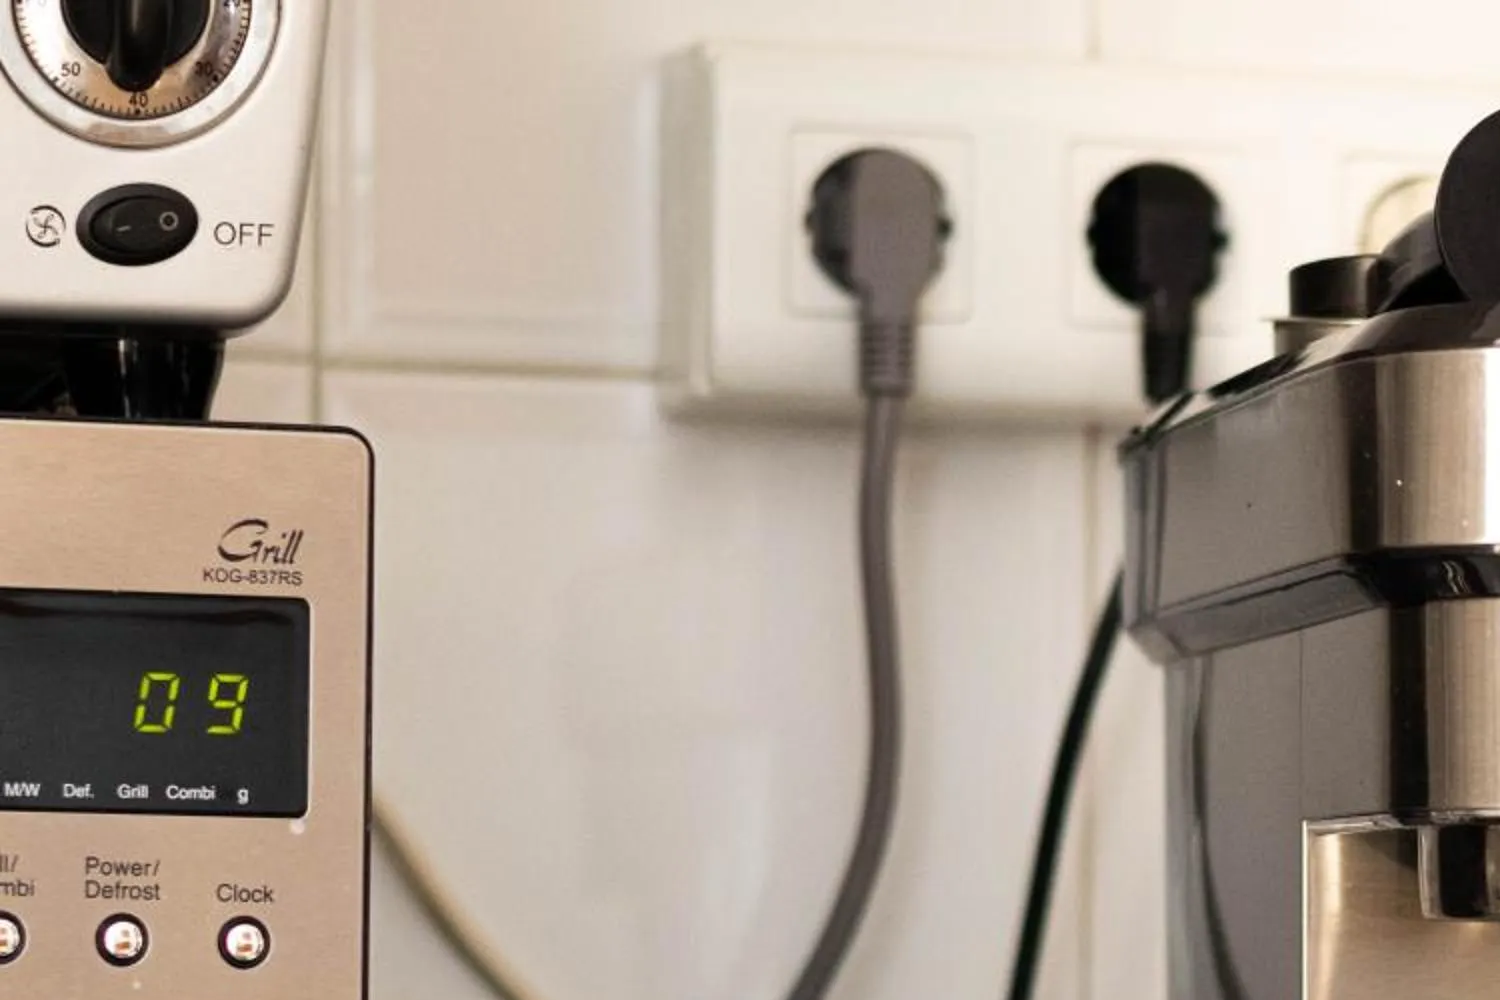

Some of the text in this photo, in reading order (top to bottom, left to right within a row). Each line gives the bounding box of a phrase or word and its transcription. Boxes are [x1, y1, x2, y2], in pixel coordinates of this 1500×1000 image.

[61, 62, 81, 77] 50
[129, 92, 148, 108] 40
[213, 222, 275, 246] OFF
[217, 518, 304, 564] Grill
[203, 567, 304, 586] KOG-837RS
[4, 782, 41, 797] M/W
[63, 784, 94, 798] Def.
[117, 785, 149, 798] Grill
[166, 785, 216, 800] Combi
[85, 856, 161, 877] Power/
[85, 880, 160, 900] Defrost
[217, 883, 274, 903] Clock
